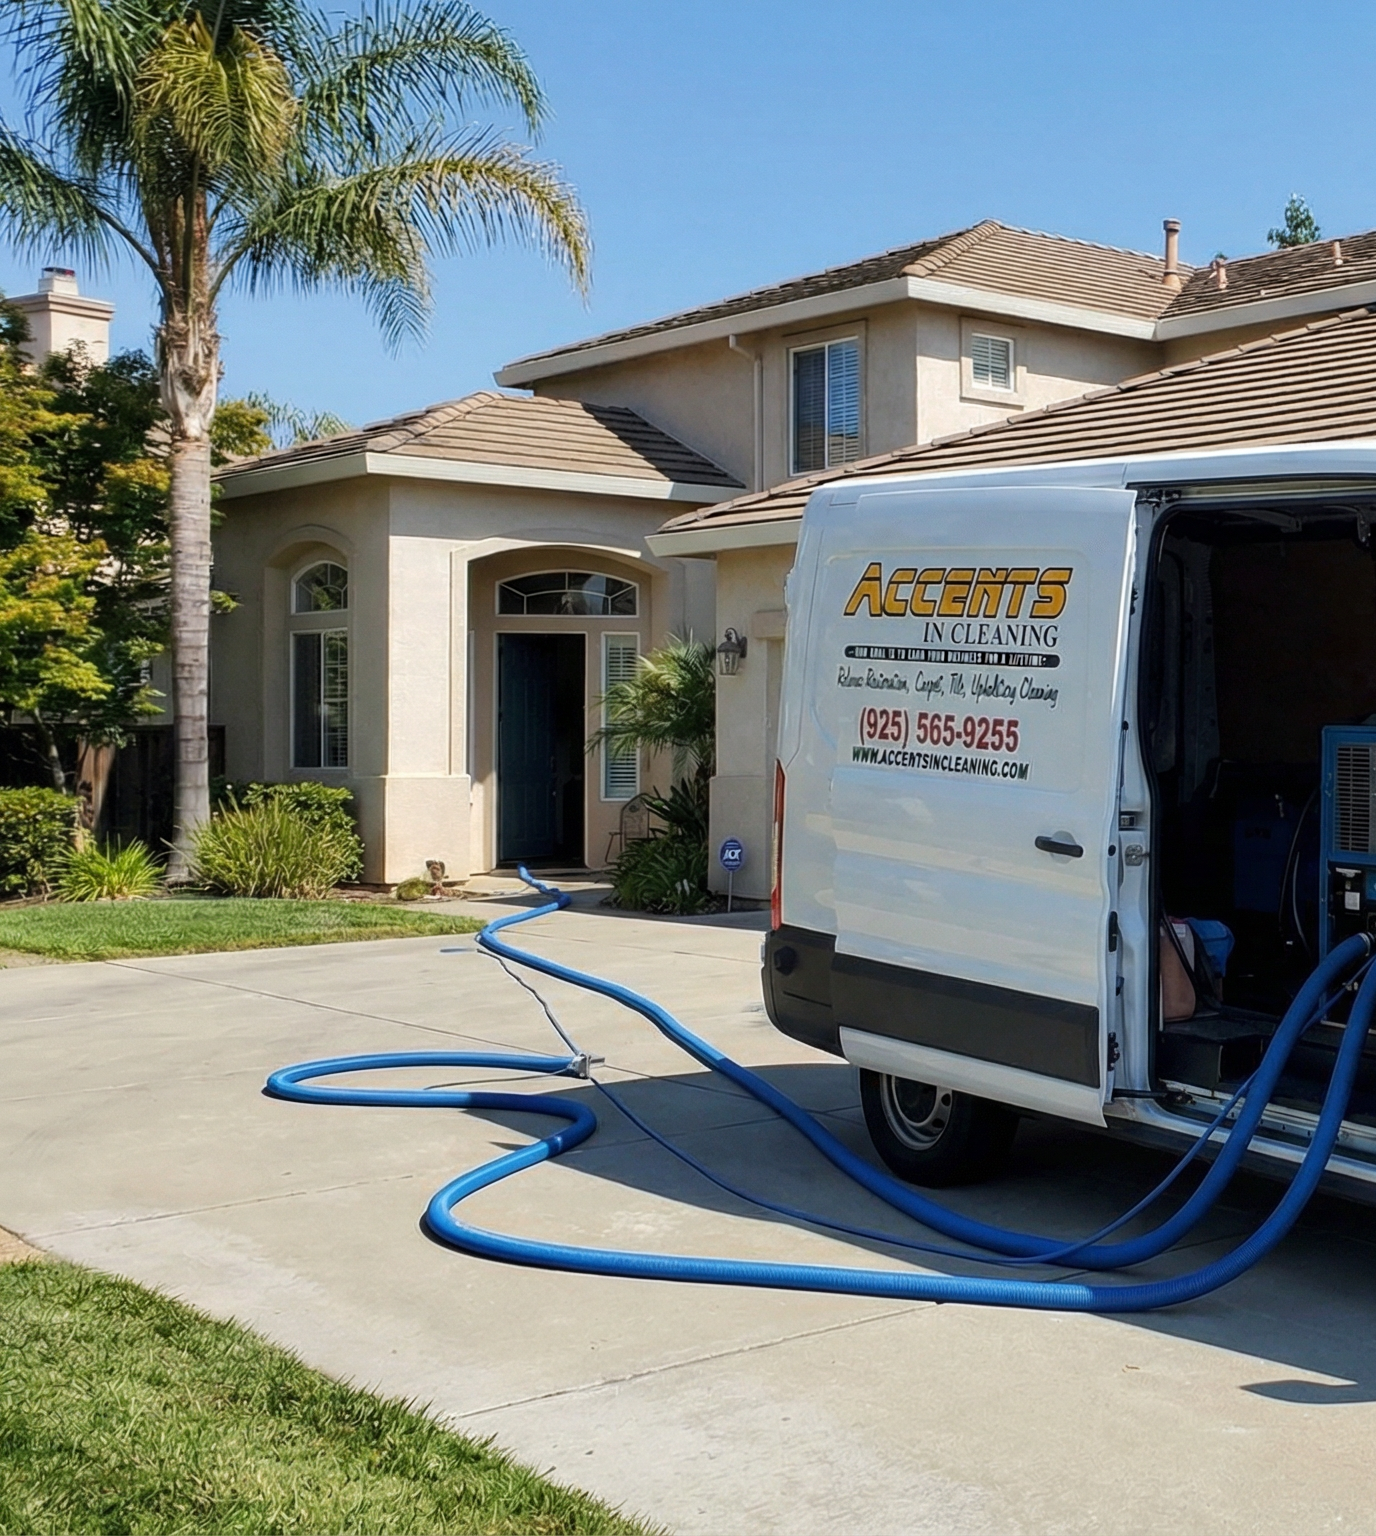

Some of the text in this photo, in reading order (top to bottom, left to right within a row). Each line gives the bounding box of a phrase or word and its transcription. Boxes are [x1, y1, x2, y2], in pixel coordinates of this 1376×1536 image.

[843, 562, 1073, 619] ACCENTS
[923, 622, 1059, 648] IN CLEANING
[859, 707, 1019, 752] (925) 565-9255
